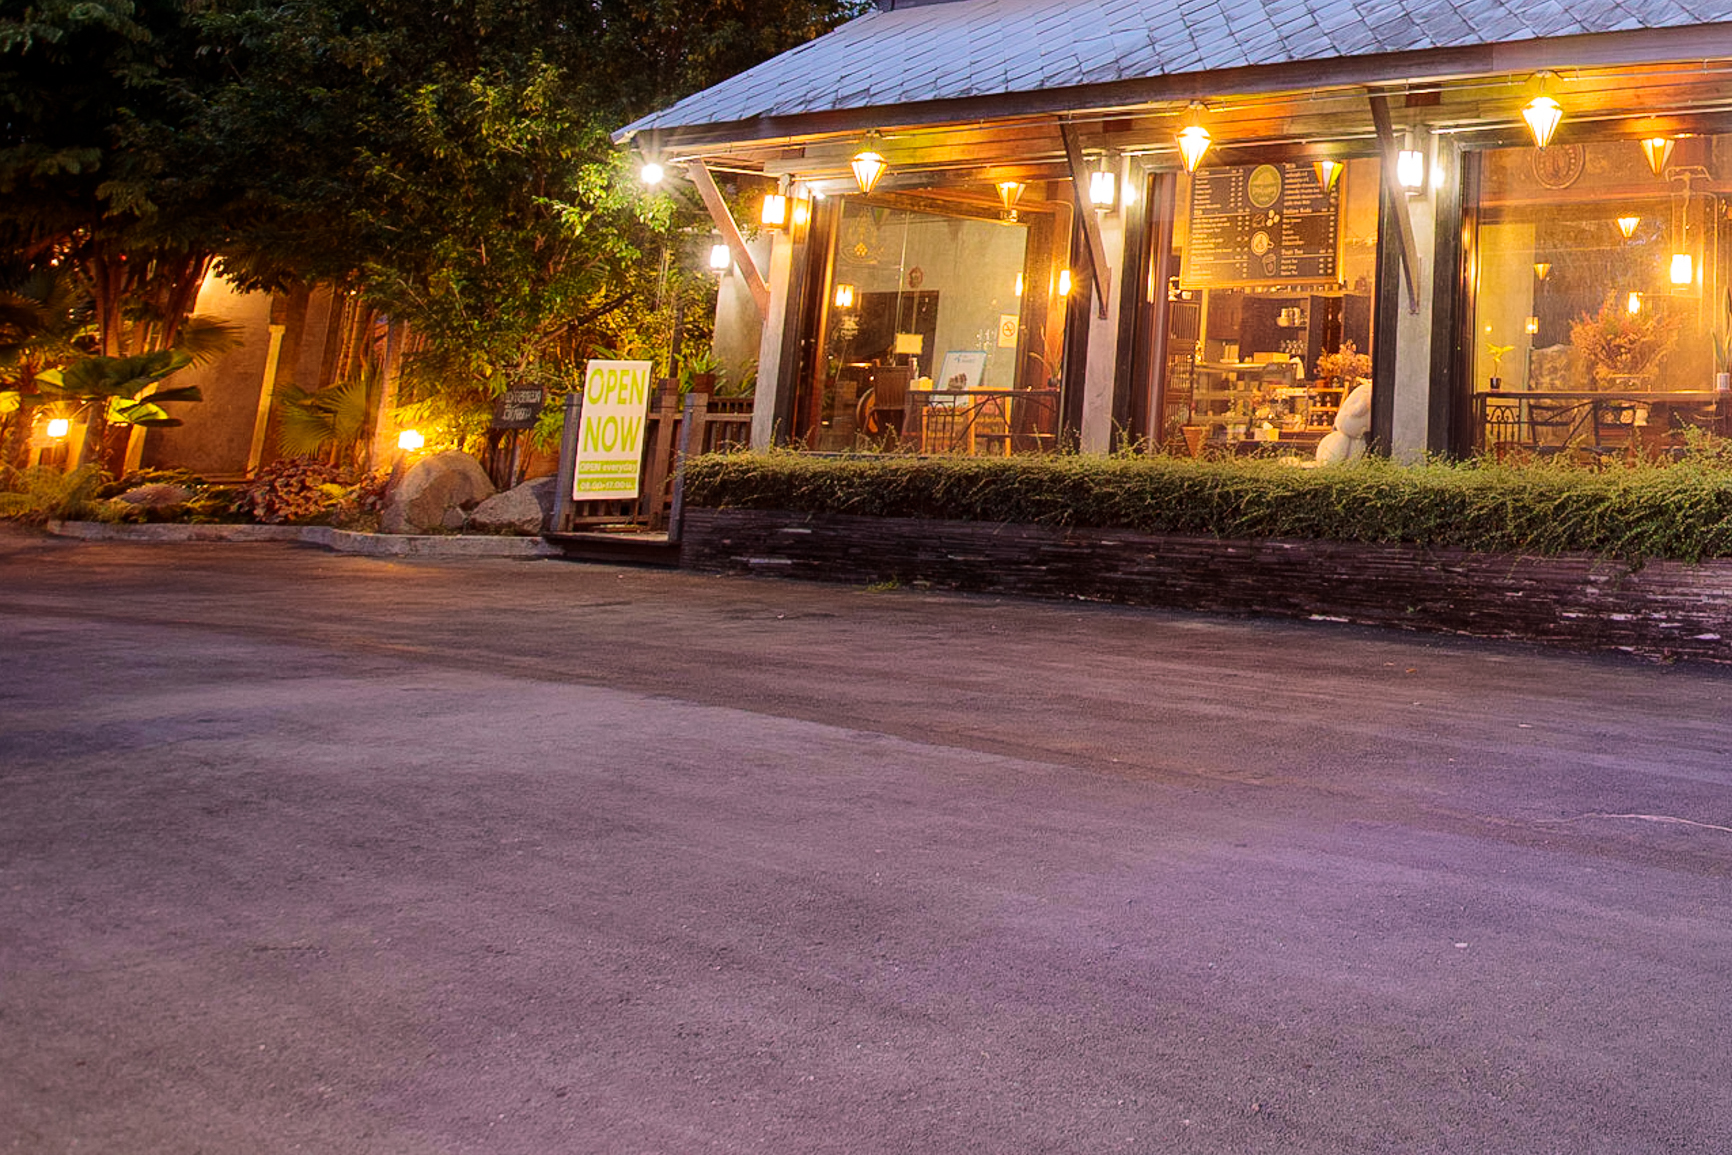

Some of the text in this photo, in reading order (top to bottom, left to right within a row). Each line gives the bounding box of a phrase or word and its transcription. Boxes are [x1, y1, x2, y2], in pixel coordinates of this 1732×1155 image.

[587, 368, 646, 405] OPEN
[583, 415, 642, 453] NOW
[580, 462, 637, 474] OPEN everyday
